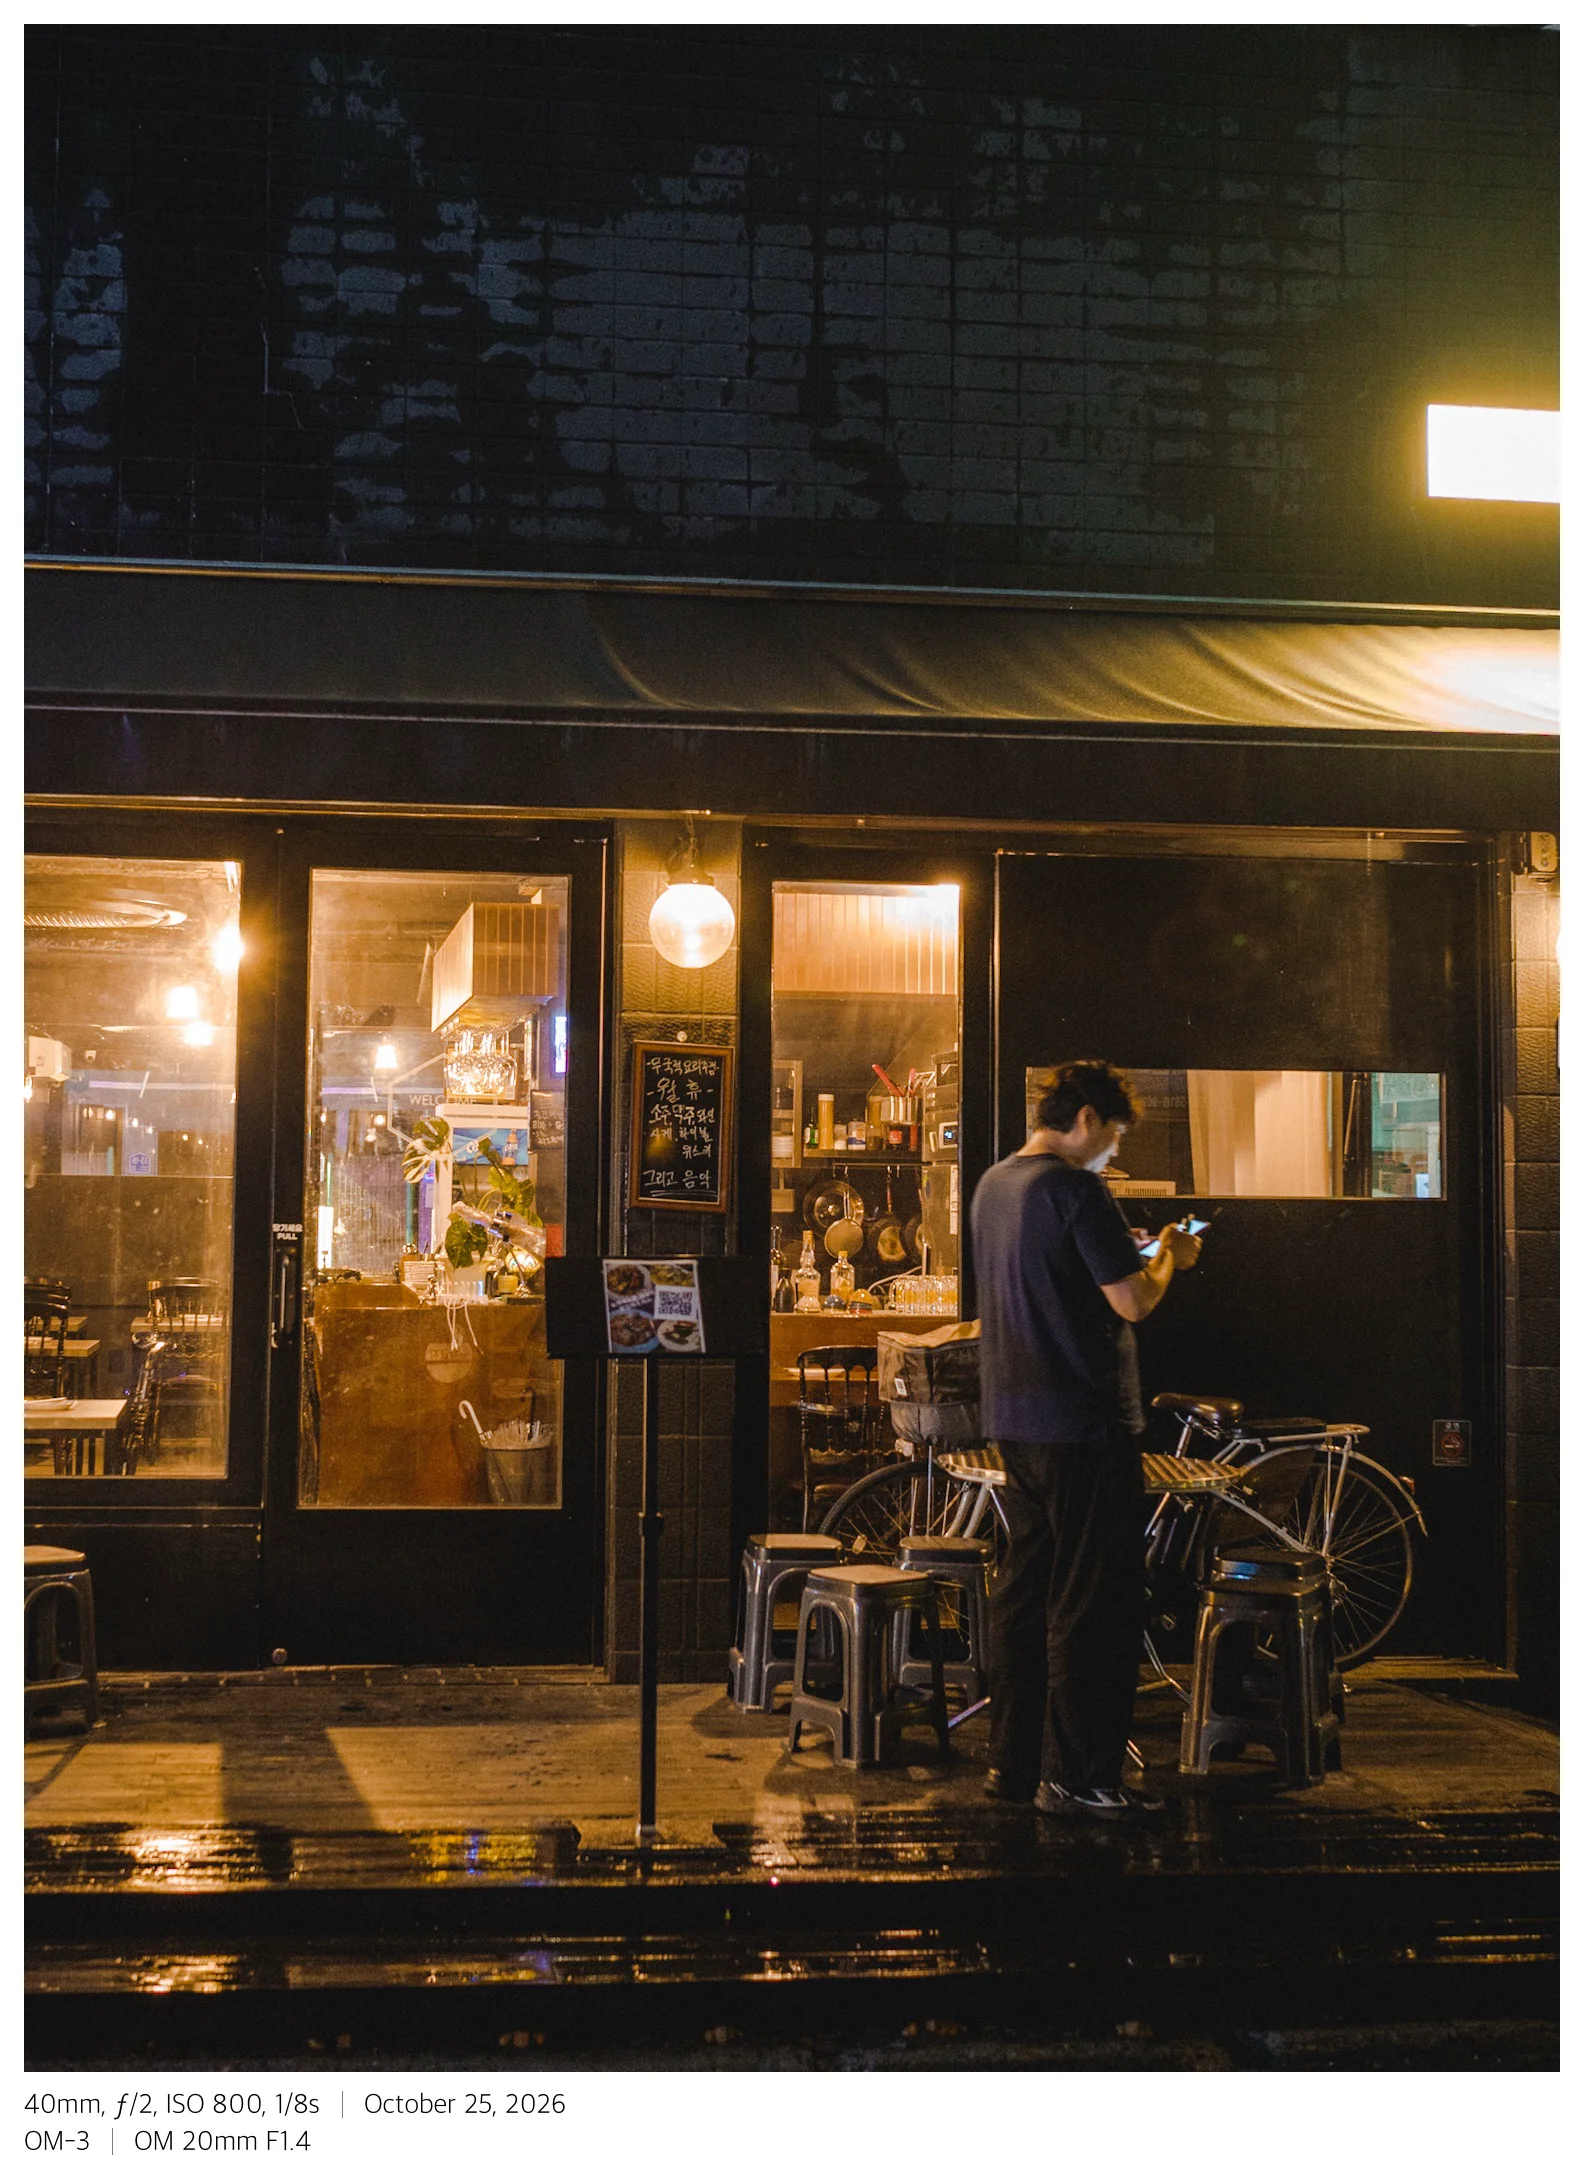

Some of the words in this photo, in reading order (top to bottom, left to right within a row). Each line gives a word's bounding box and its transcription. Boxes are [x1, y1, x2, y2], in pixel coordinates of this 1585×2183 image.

[679, 1125, 714, 1143] 하이볼
[682, 1143, 712, 1159] 위스키
[643, 1169, 678, 1188] 그리고
[682, 1170, 711, 1189] 음악
[276, 1232, 298, 1241] PULL
